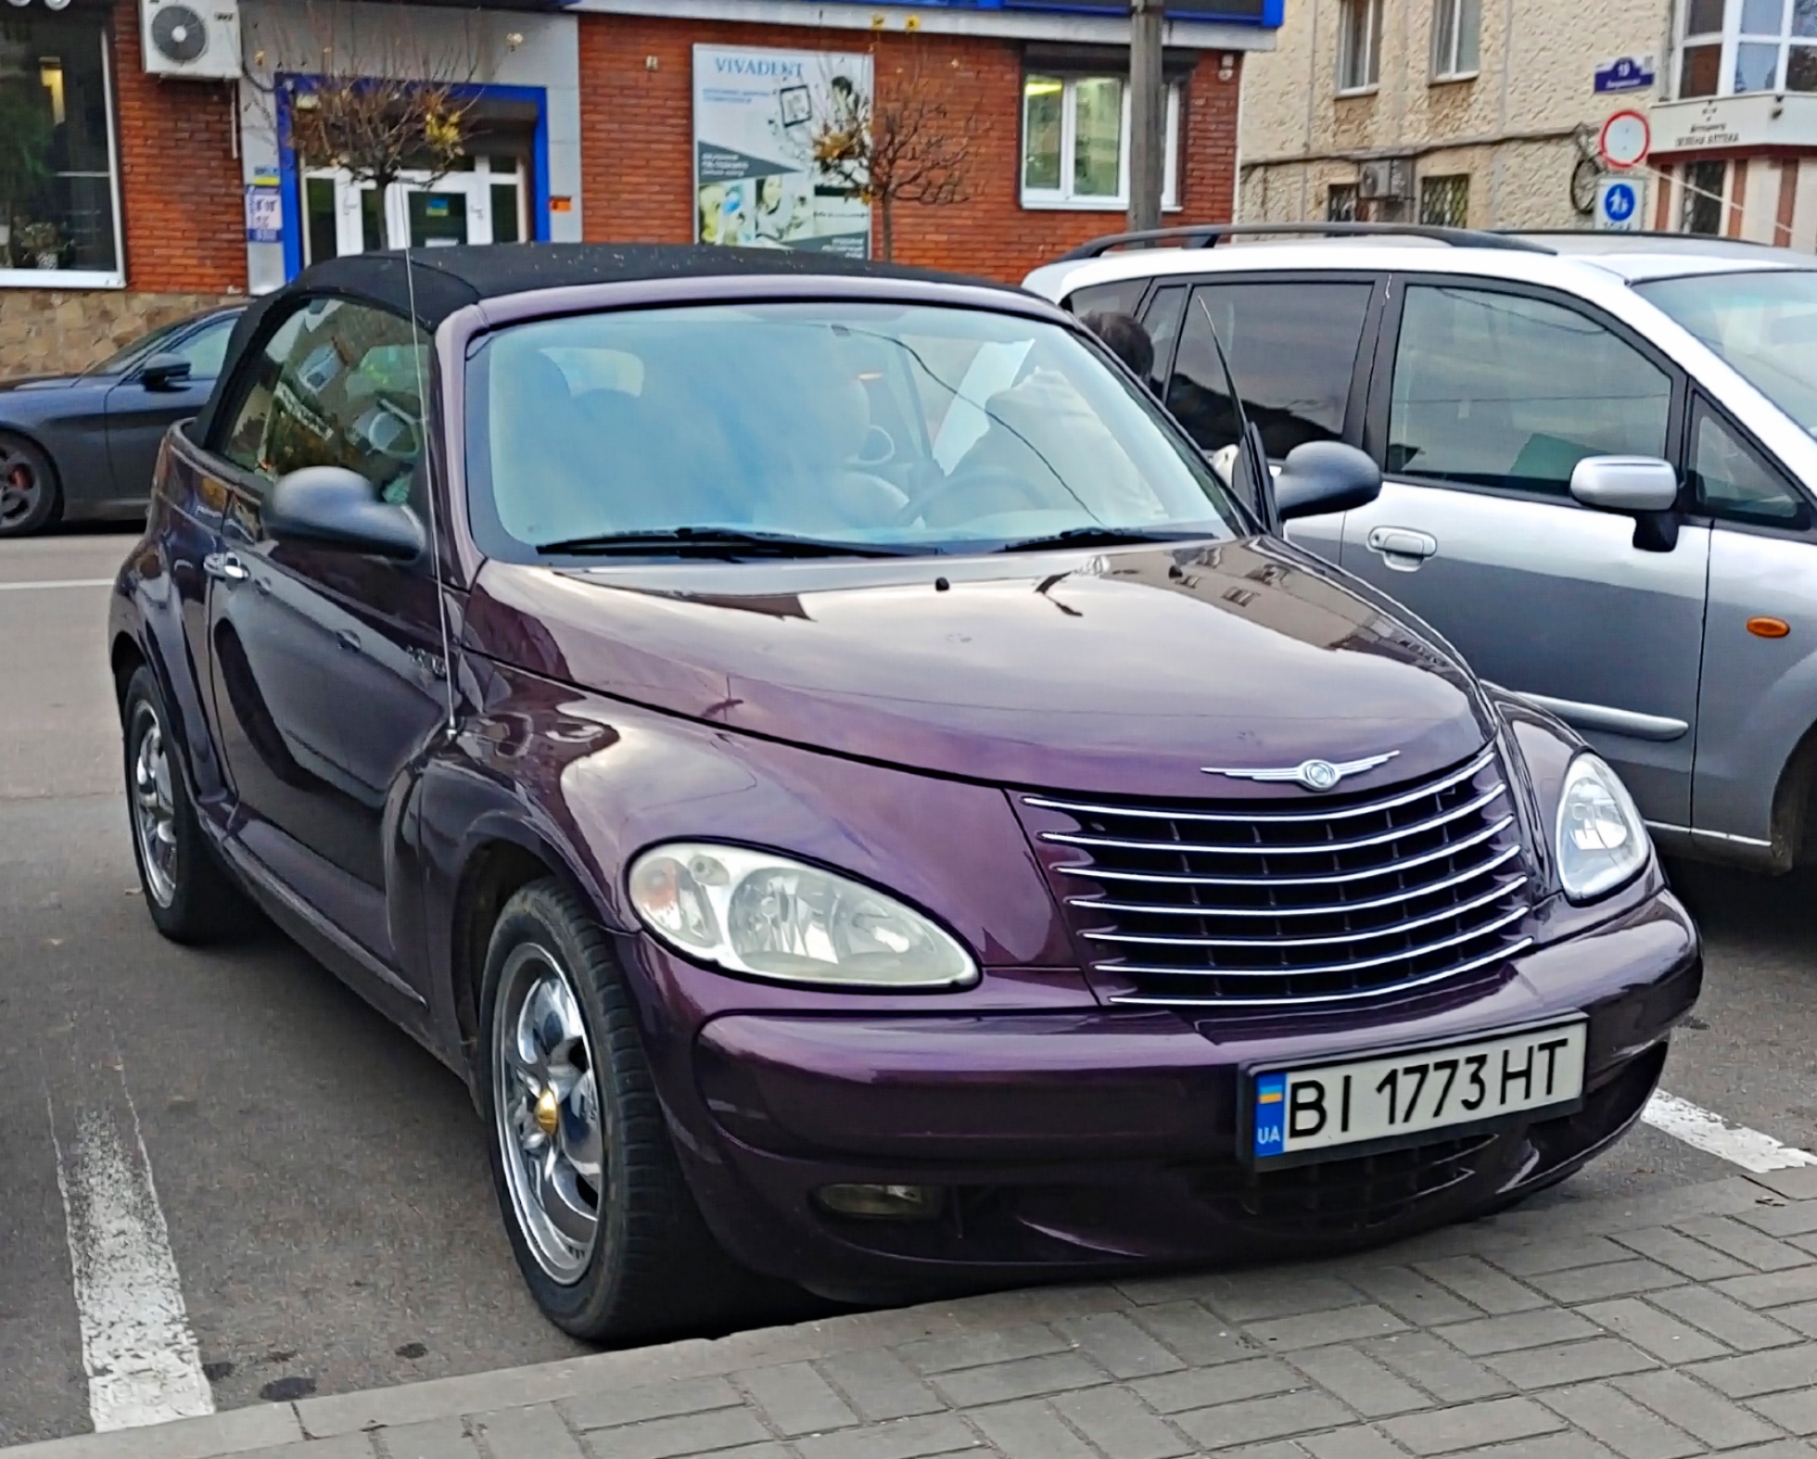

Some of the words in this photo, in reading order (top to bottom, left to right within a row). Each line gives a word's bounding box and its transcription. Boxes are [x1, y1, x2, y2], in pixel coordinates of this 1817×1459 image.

[715, 57, 802, 77] VIVADENT
[1288, 1074, 1351, 1139] BI
[1376, 1053, 1488, 1125] 1773
[1500, 1037, 1568, 1105] HT
[1256, 1126, 1281, 1145] UA
